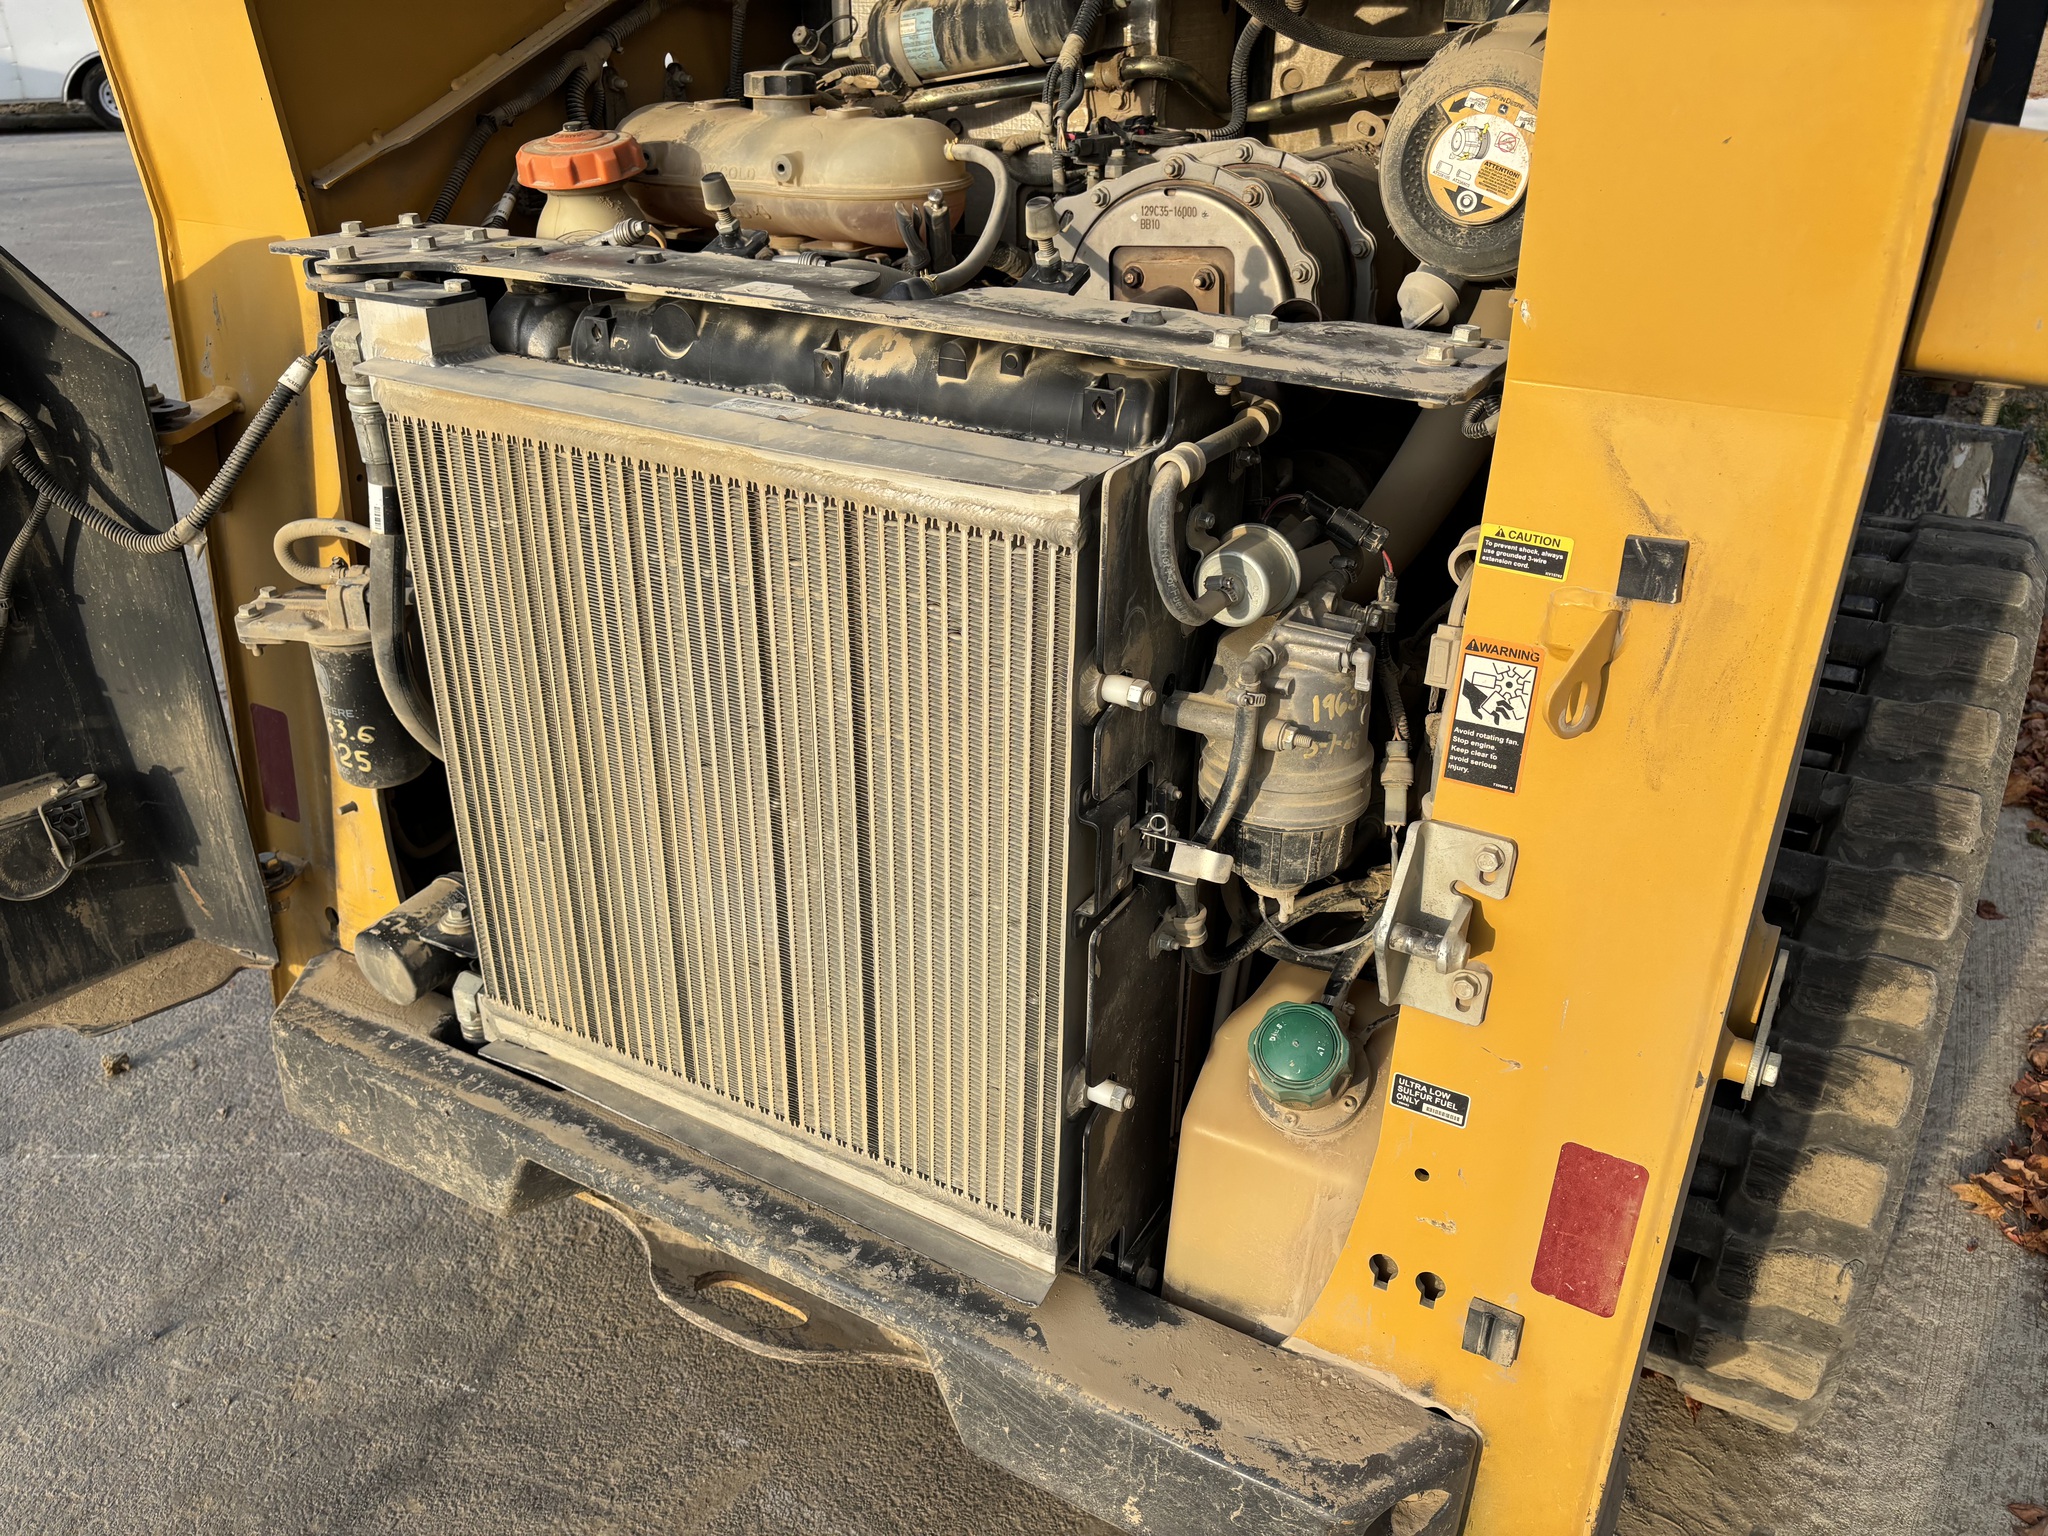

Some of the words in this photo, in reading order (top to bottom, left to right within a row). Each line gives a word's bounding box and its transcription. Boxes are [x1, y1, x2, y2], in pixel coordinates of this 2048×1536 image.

[1484, 160, 1520, 180] ATTENTION!
[1140, 218, 1160, 230] BB10
[1508, 530, 1561, 548] CAUTION
[1494, 542, 1518, 551] prevent
[1518, 546, 1540, 556] shock,
[1541, 550, 1564, 560] always
[1496, 550, 1526, 560] grounded
[1527, 556, 1547, 564] 3-wire
[1482, 556, 1512, 565] extension
[1513, 560, 1530, 569] cord.
[1480, 642, 1540, 662] WARNING
[1452, 735, 1470, 745] Stop
[1470, 740, 1497, 750] engine.
[1454, 726, 1475, 737] Avoid
[1476, 732, 1504, 743] rotating
[1506, 738, 1520, 746] fan.
[1450, 744, 1470, 755] Keep
[1470, 750, 1488, 758] clear
[1490, 752, 1498, 760] to
[1448, 763, 1470, 773] injury.
[1449, 754, 1469, 764] avoid
[1470, 759, 1497, 770] serious
[1398, 1078, 1428, 1092] ULTRA
[1429, 1088, 1451, 1100] LOW
[1396, 1092, 1420, 1106] ONLY
[1397, 1085, 1432, 1102] SULFUR
[1434, 1097, 1458, 1110] FUEL
